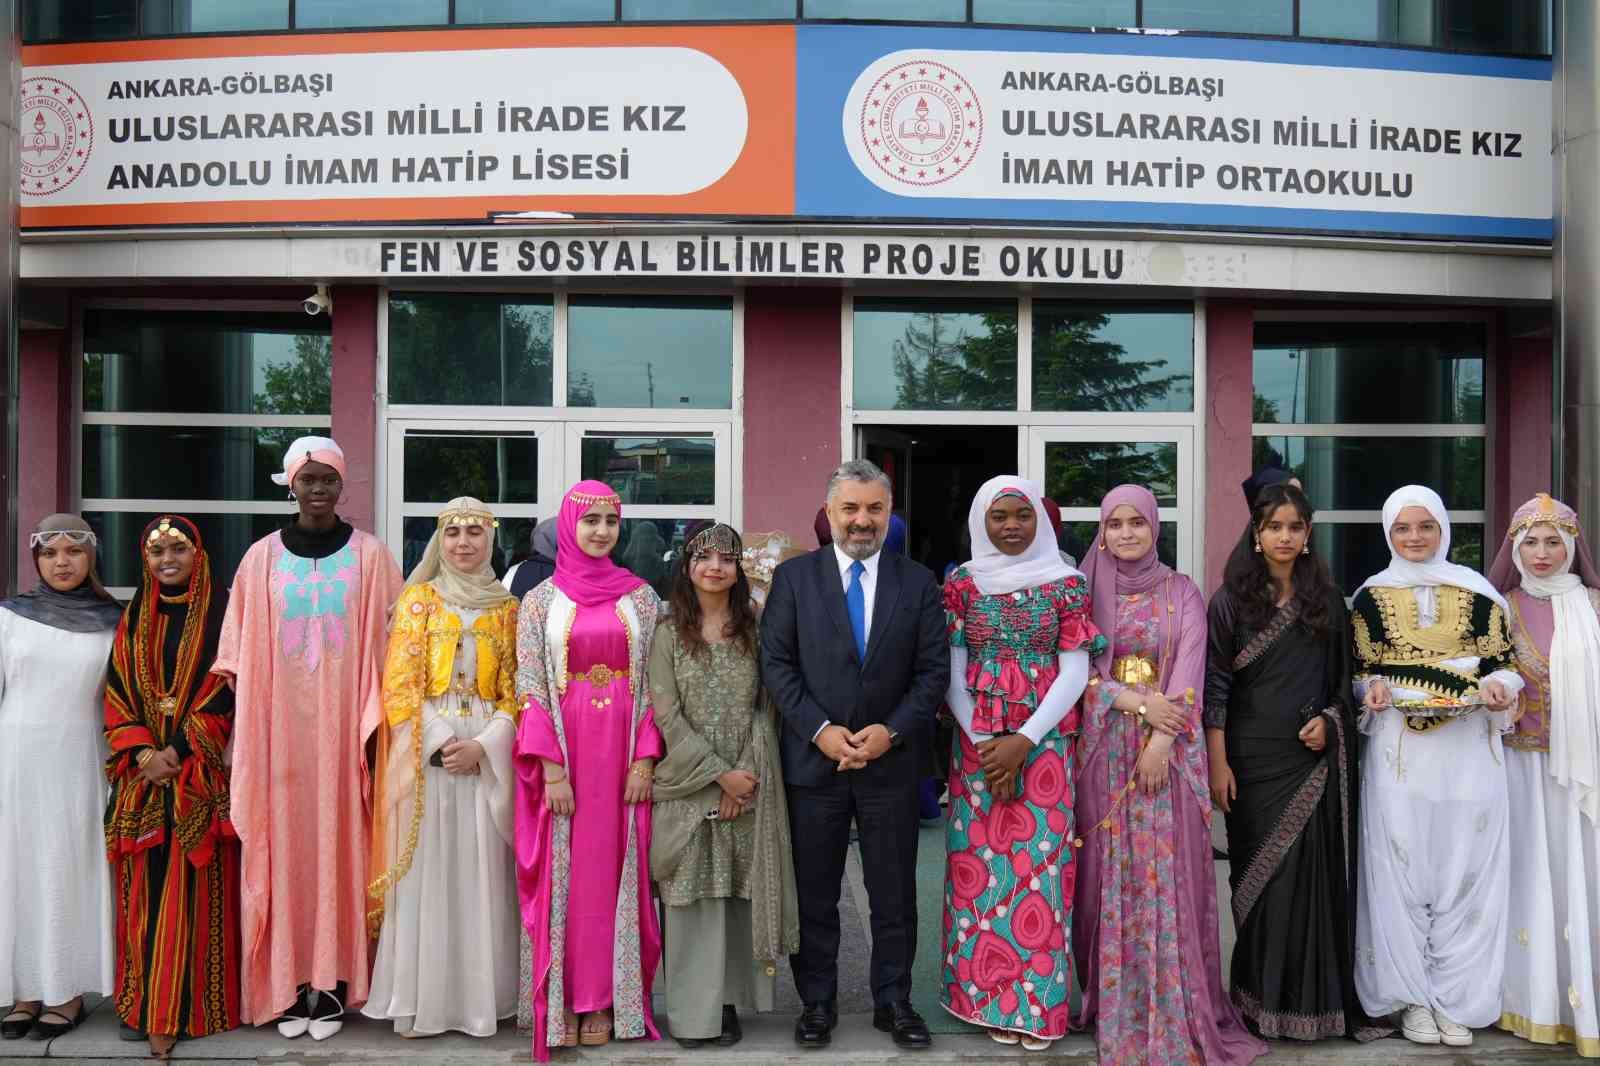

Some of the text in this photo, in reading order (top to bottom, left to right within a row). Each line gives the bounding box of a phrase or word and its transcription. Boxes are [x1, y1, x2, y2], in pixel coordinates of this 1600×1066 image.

[107, 72, 333, 100] ANKARA-GÖLBAŞI
[1001, 70, 1224, 101] ANKARA-GÖLBAŞI
[108, 101, 686, 143] ULUSLARARASI MİLLİ İRADE KIZ
[1002, 109, 1523, 159] ULUSLARARASI MİLLİ İRADE KIZ
[106, 147, 629, 191] ANADOLU İMAM HATİP LİSESİ
[1002, 153, 1413, 199] İMAM HATİP ORTAOKULU
[380, 241, 441, 273] FEN
[455, 240, 499, 273] VE
[516, 239, 658, 273] SOSYAL
[676, 235, 845, 274] BİLİMLER
[863, 243, 981, 277] PROJE
[999, 245, 1124, 281] OKULU
